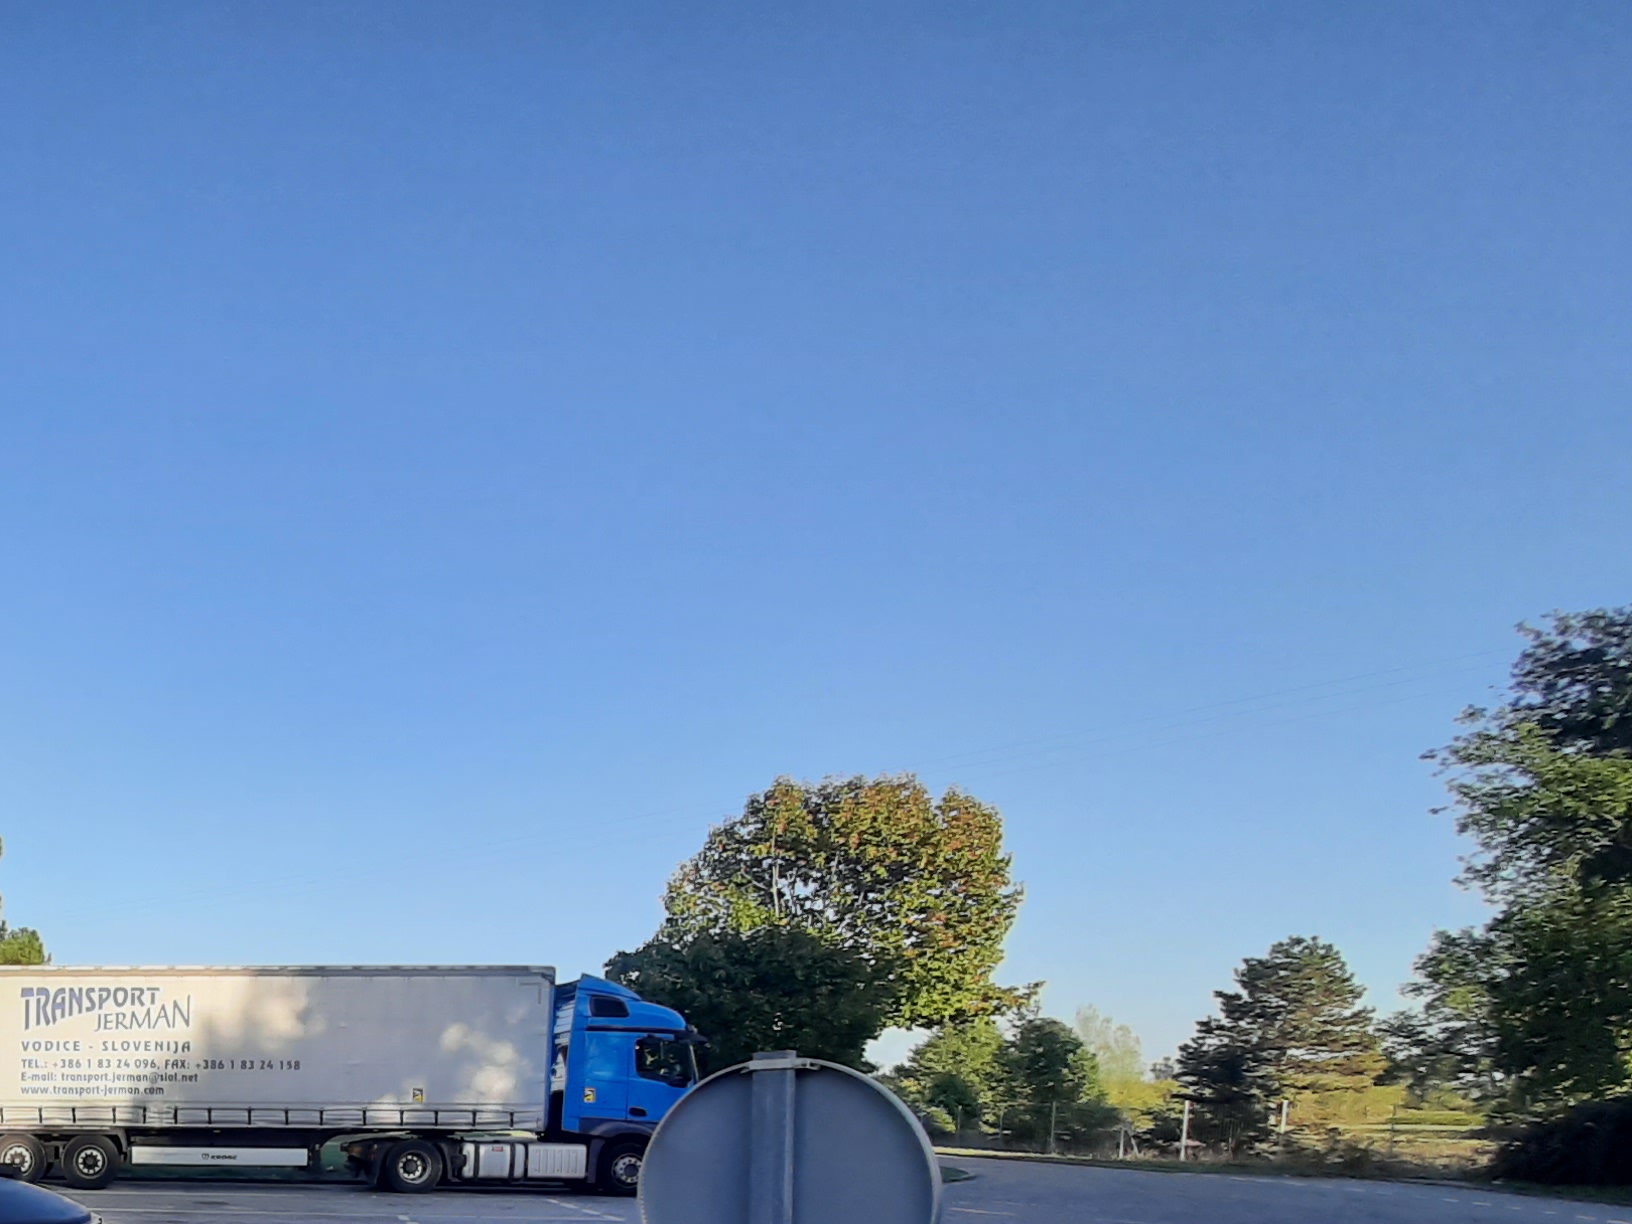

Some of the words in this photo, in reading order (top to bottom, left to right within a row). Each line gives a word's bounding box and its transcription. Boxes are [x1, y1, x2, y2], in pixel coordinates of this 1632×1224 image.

[20, 987, 160, 1031] TRANSPORT
[94, 994, 191, 1032] JERMAN
[21, 1041, 81, 1052] VODICE
[101, 1041, 191, 1053] SLOVENIJA
[52, 1059, 82, 1069] +386
[87, 1059, 92, 1069] 1
[97, 1059, 112, 1069] 83
[116, 1059, 130, 1069] 24
[164, 1060, 190, 1070] FAX:
[195, 1060, 225, 1070] +386
[230, 1060, 235, 1070] 1
[240, 1060, 255, 1070] 83
[259, 1060, 273, 1070] 24
[21, 1072, 57, 1082] E-mail:
[20, 1085, 165, 1097] www.transport-jerman.com
